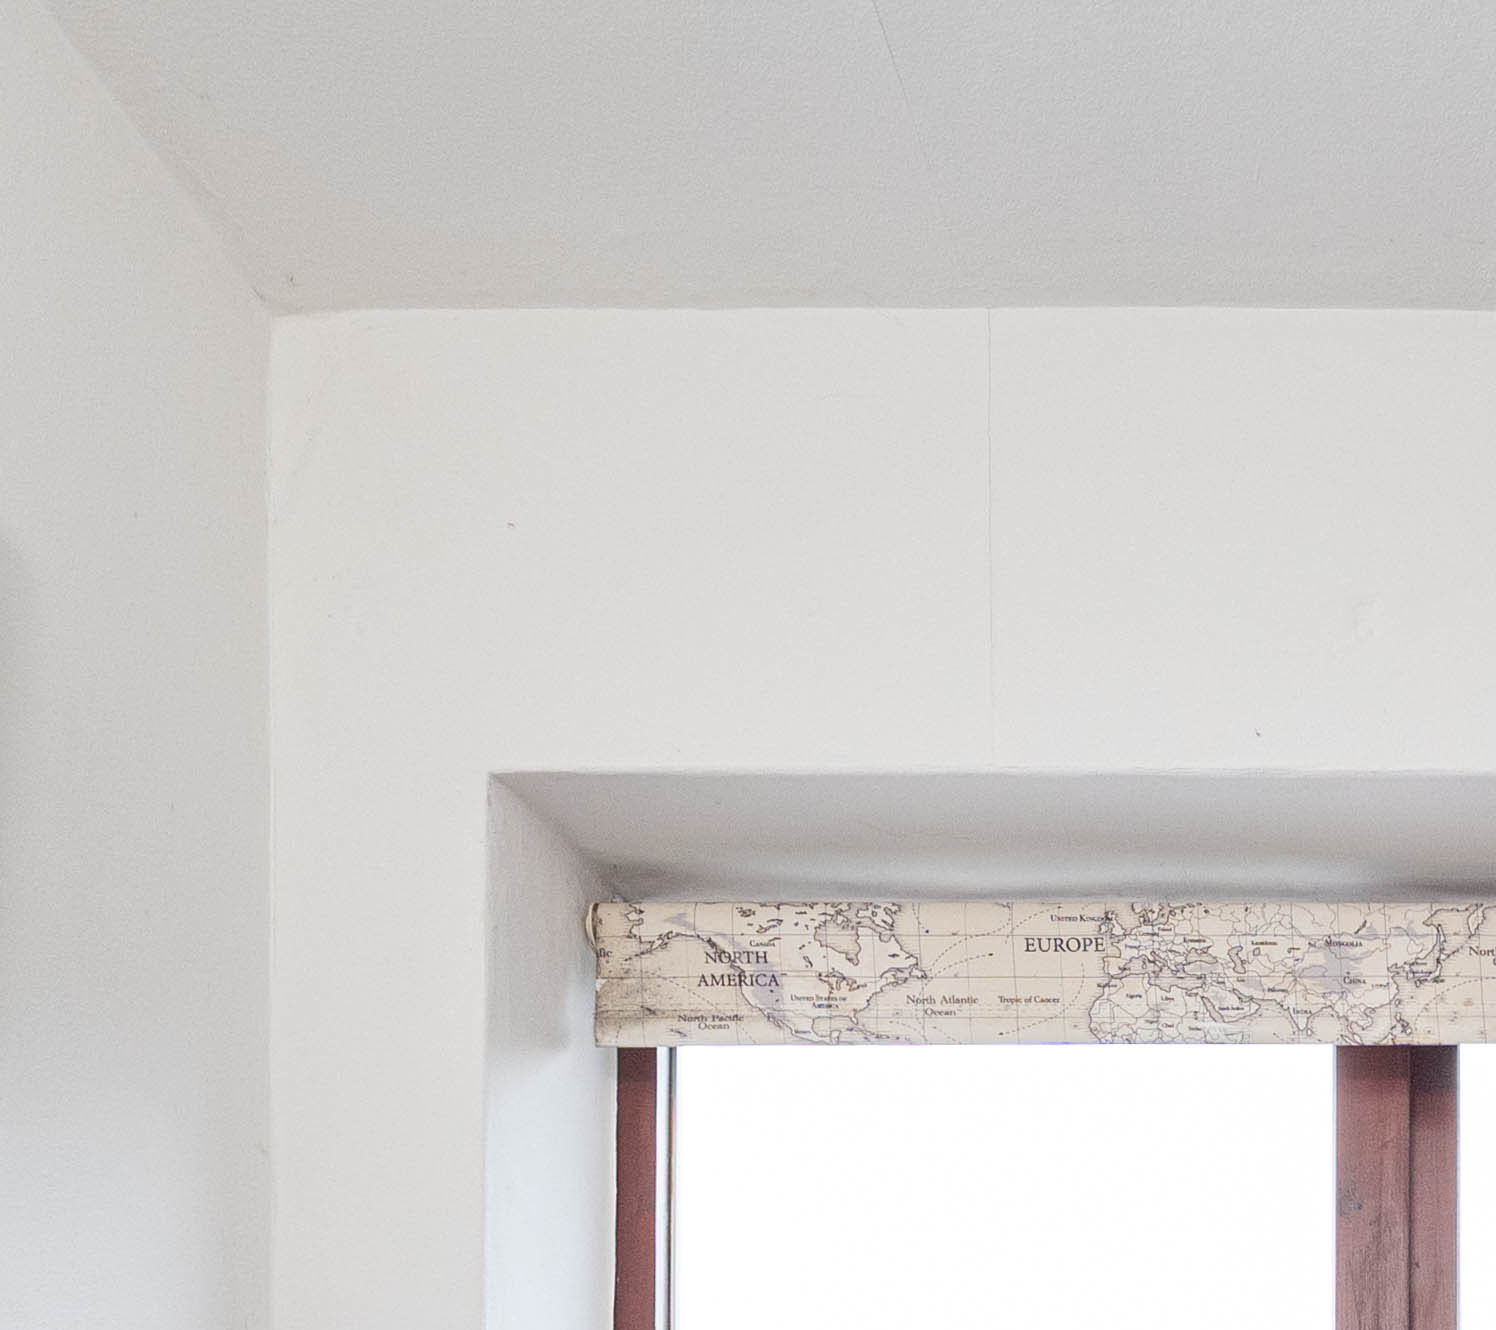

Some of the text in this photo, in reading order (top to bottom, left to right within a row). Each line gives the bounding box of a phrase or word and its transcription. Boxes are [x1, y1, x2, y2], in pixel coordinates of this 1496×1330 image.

[1025, 936, 1106, 953] EUROPE
[705, 950, 769, 965] NORTH
[697, 973, 780, 987] AMERICA
[906, 993, 979, 1006] North Atlantic
